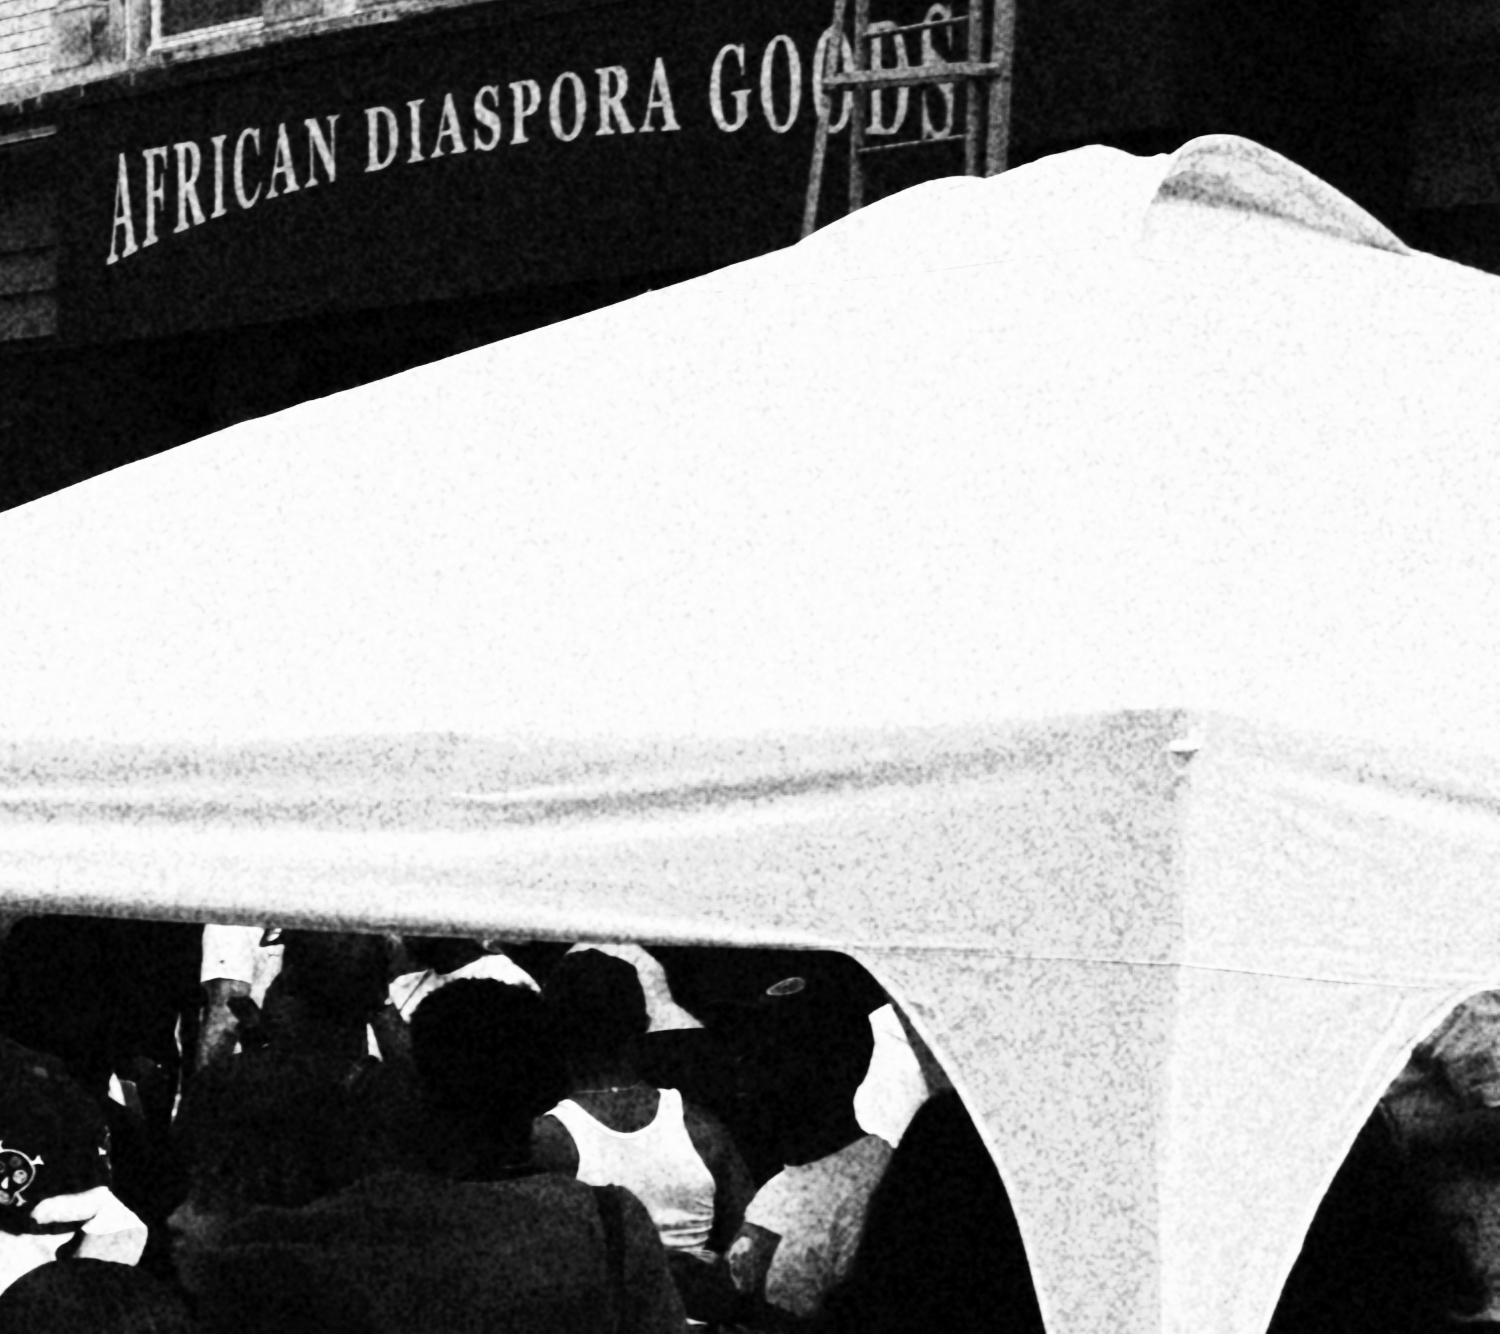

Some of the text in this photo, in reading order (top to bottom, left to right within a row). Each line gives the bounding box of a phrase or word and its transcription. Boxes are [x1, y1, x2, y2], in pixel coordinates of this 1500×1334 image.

[106, 3, 955, 265] AFRICAN DIASPORA GOODS
